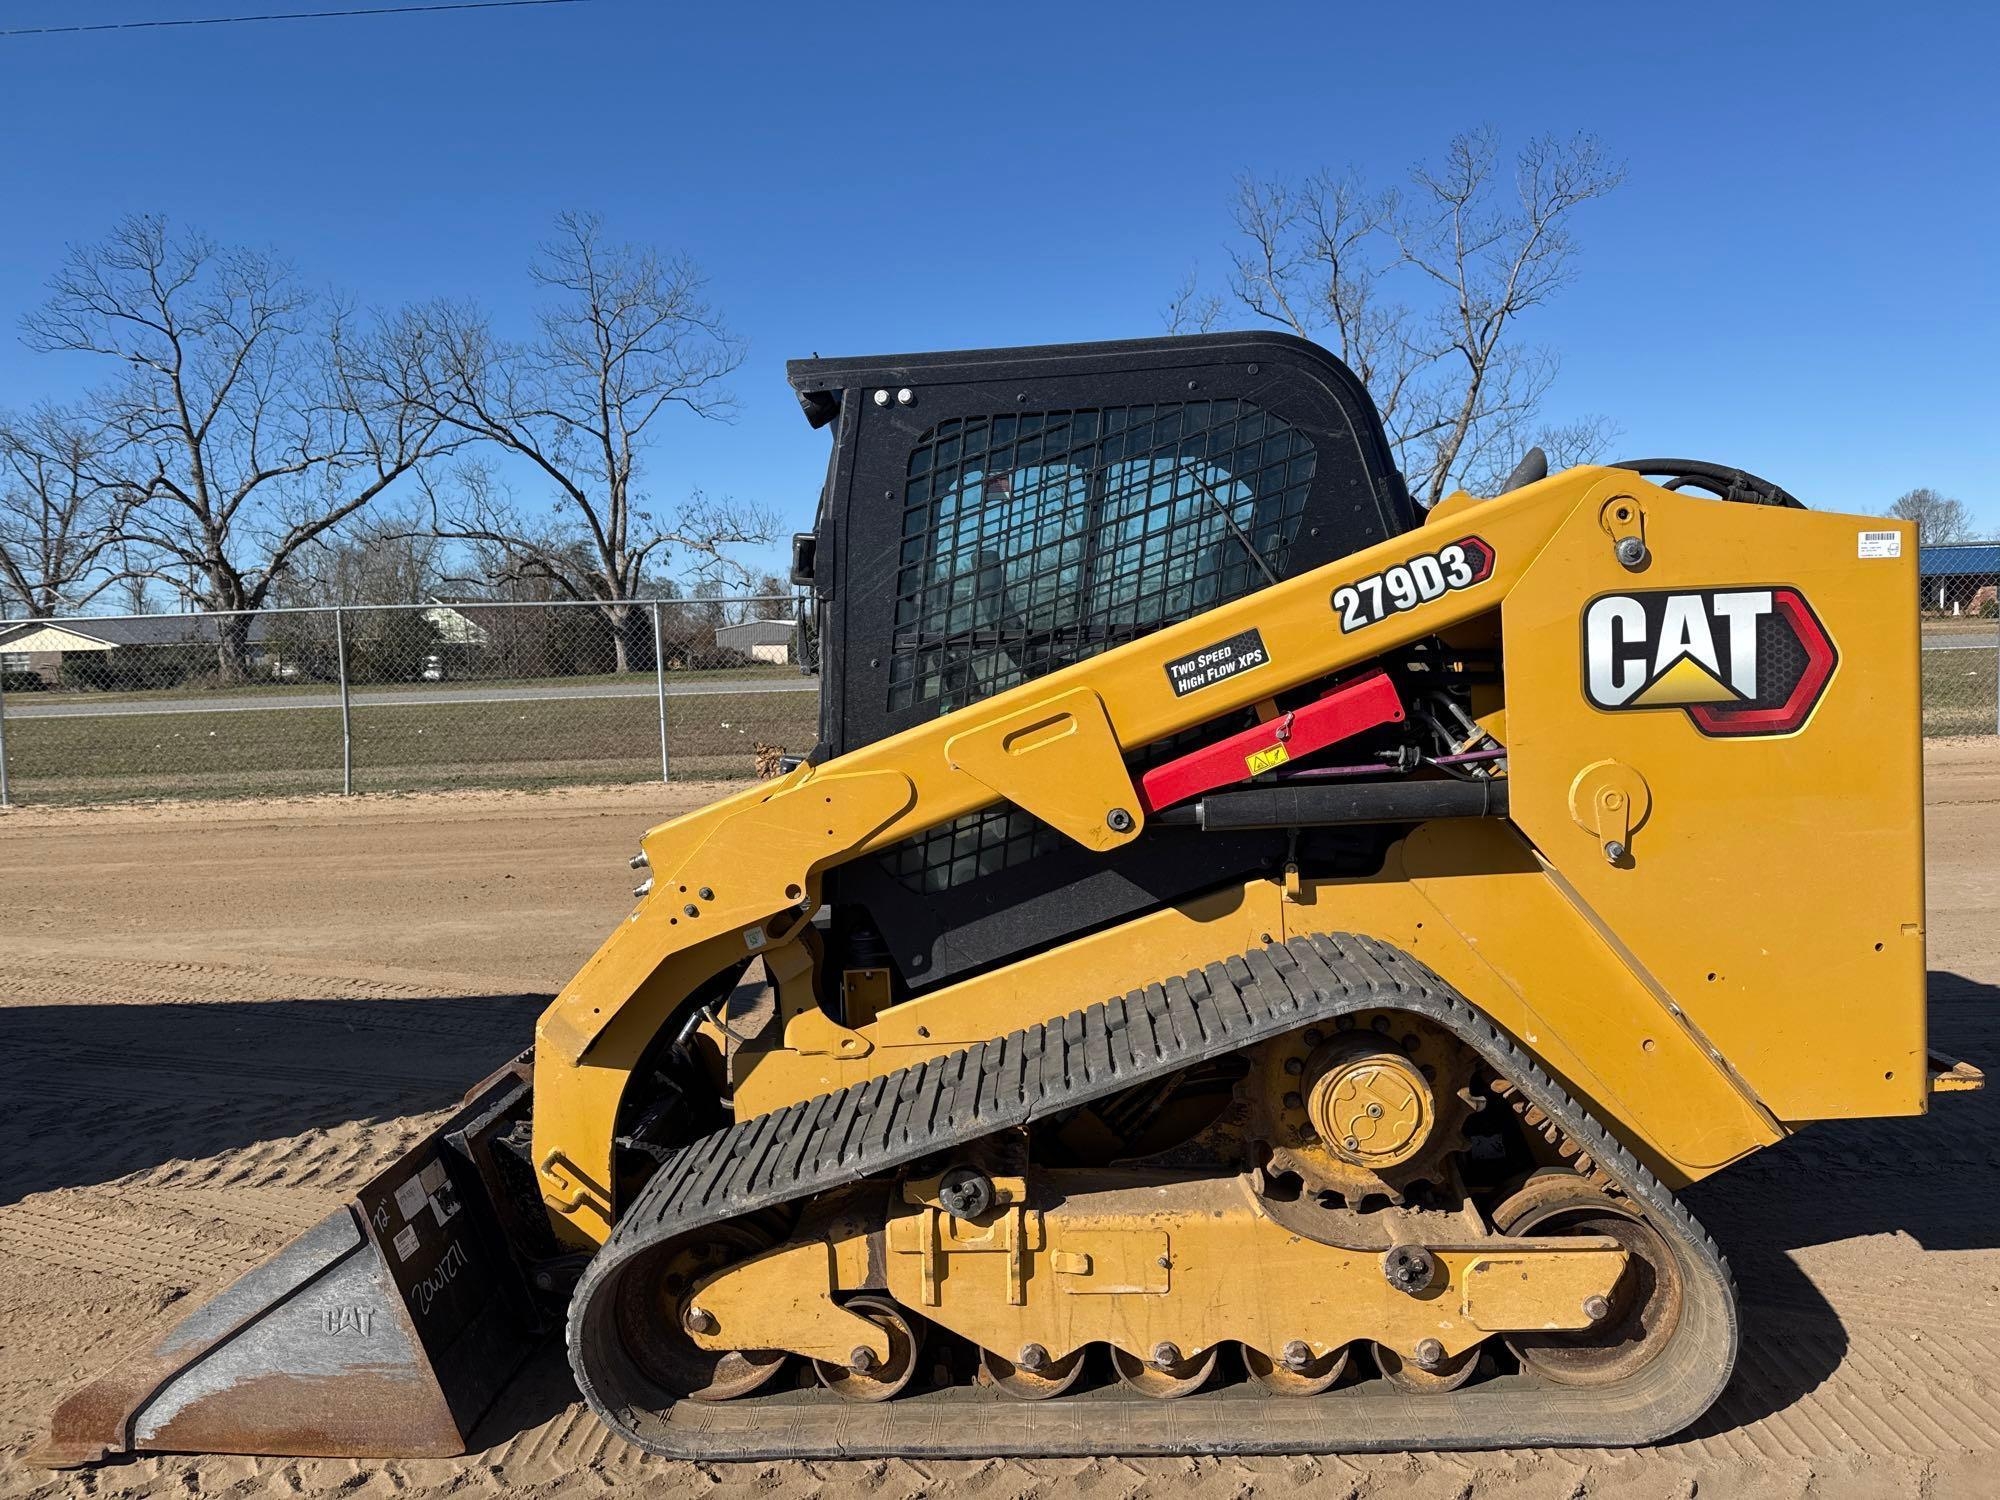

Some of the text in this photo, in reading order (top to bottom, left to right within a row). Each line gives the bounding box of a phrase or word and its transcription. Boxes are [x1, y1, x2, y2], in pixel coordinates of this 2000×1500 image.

[1333, 545, 1473, 632] 279D3
[1238, 649, 1262, 669] XPS
[1587, 591, 1772, 706] CAT
[321, 1306, 375, 1337] CAT
